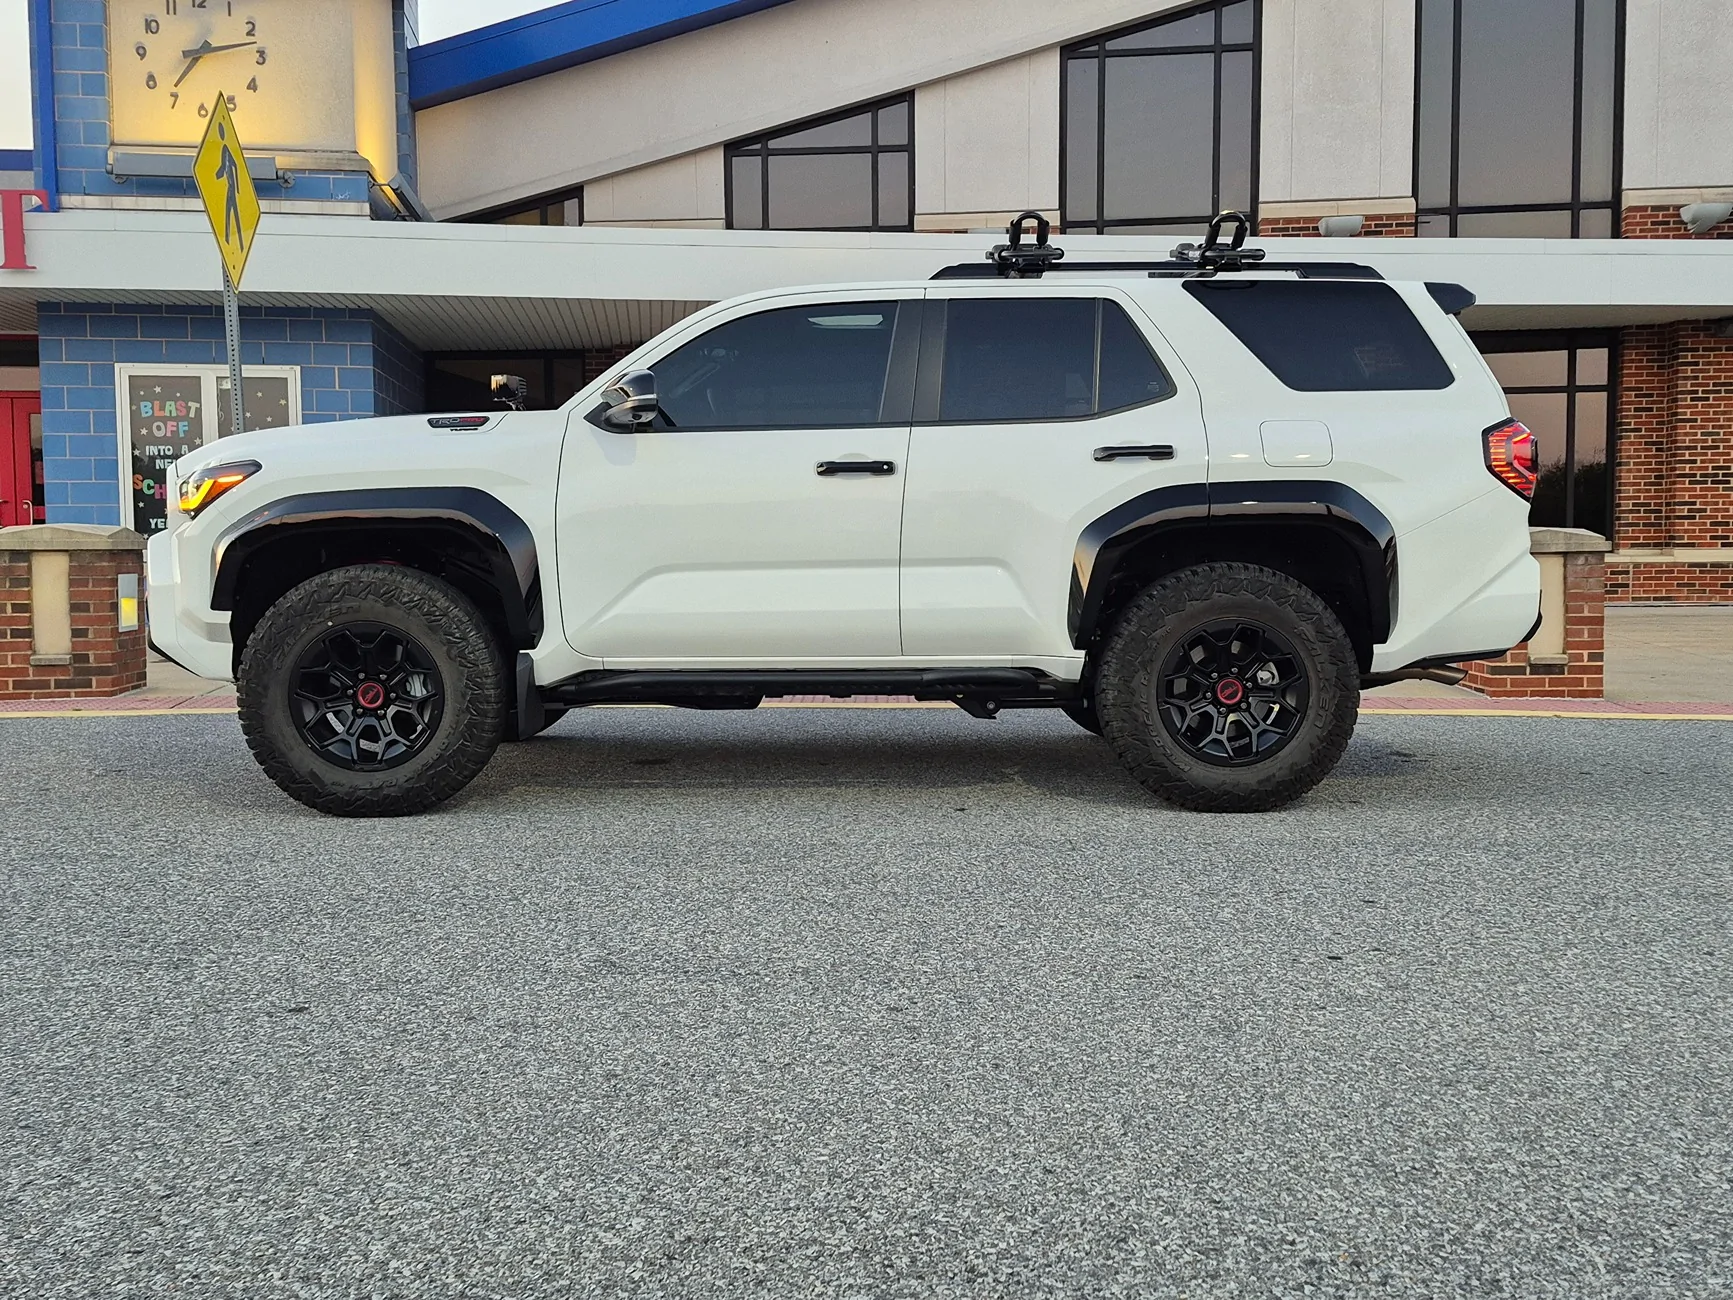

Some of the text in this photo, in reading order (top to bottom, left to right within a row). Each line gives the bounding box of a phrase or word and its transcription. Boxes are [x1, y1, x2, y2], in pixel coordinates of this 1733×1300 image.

[166, 0, 176, 15] 11
[145, 18, 159, 34] 10
[245, 21, 256, 36] 2
[135, 45, 147, 61] 9
[255, 50, 266, 65] 3
[246, 76, 258, 93] 4
[169, 92, 179, 109] 7
[226, 95, 236, 112] 5
[198, 103, 208, 118] 6
[139, 401, 200, 418] BLAST
[152, 421, 189, 438] OFF
[145, 445, 188, 456] INTO A
[155, 459, 177, 469] NE
[149, 518, 168, 529] YE
